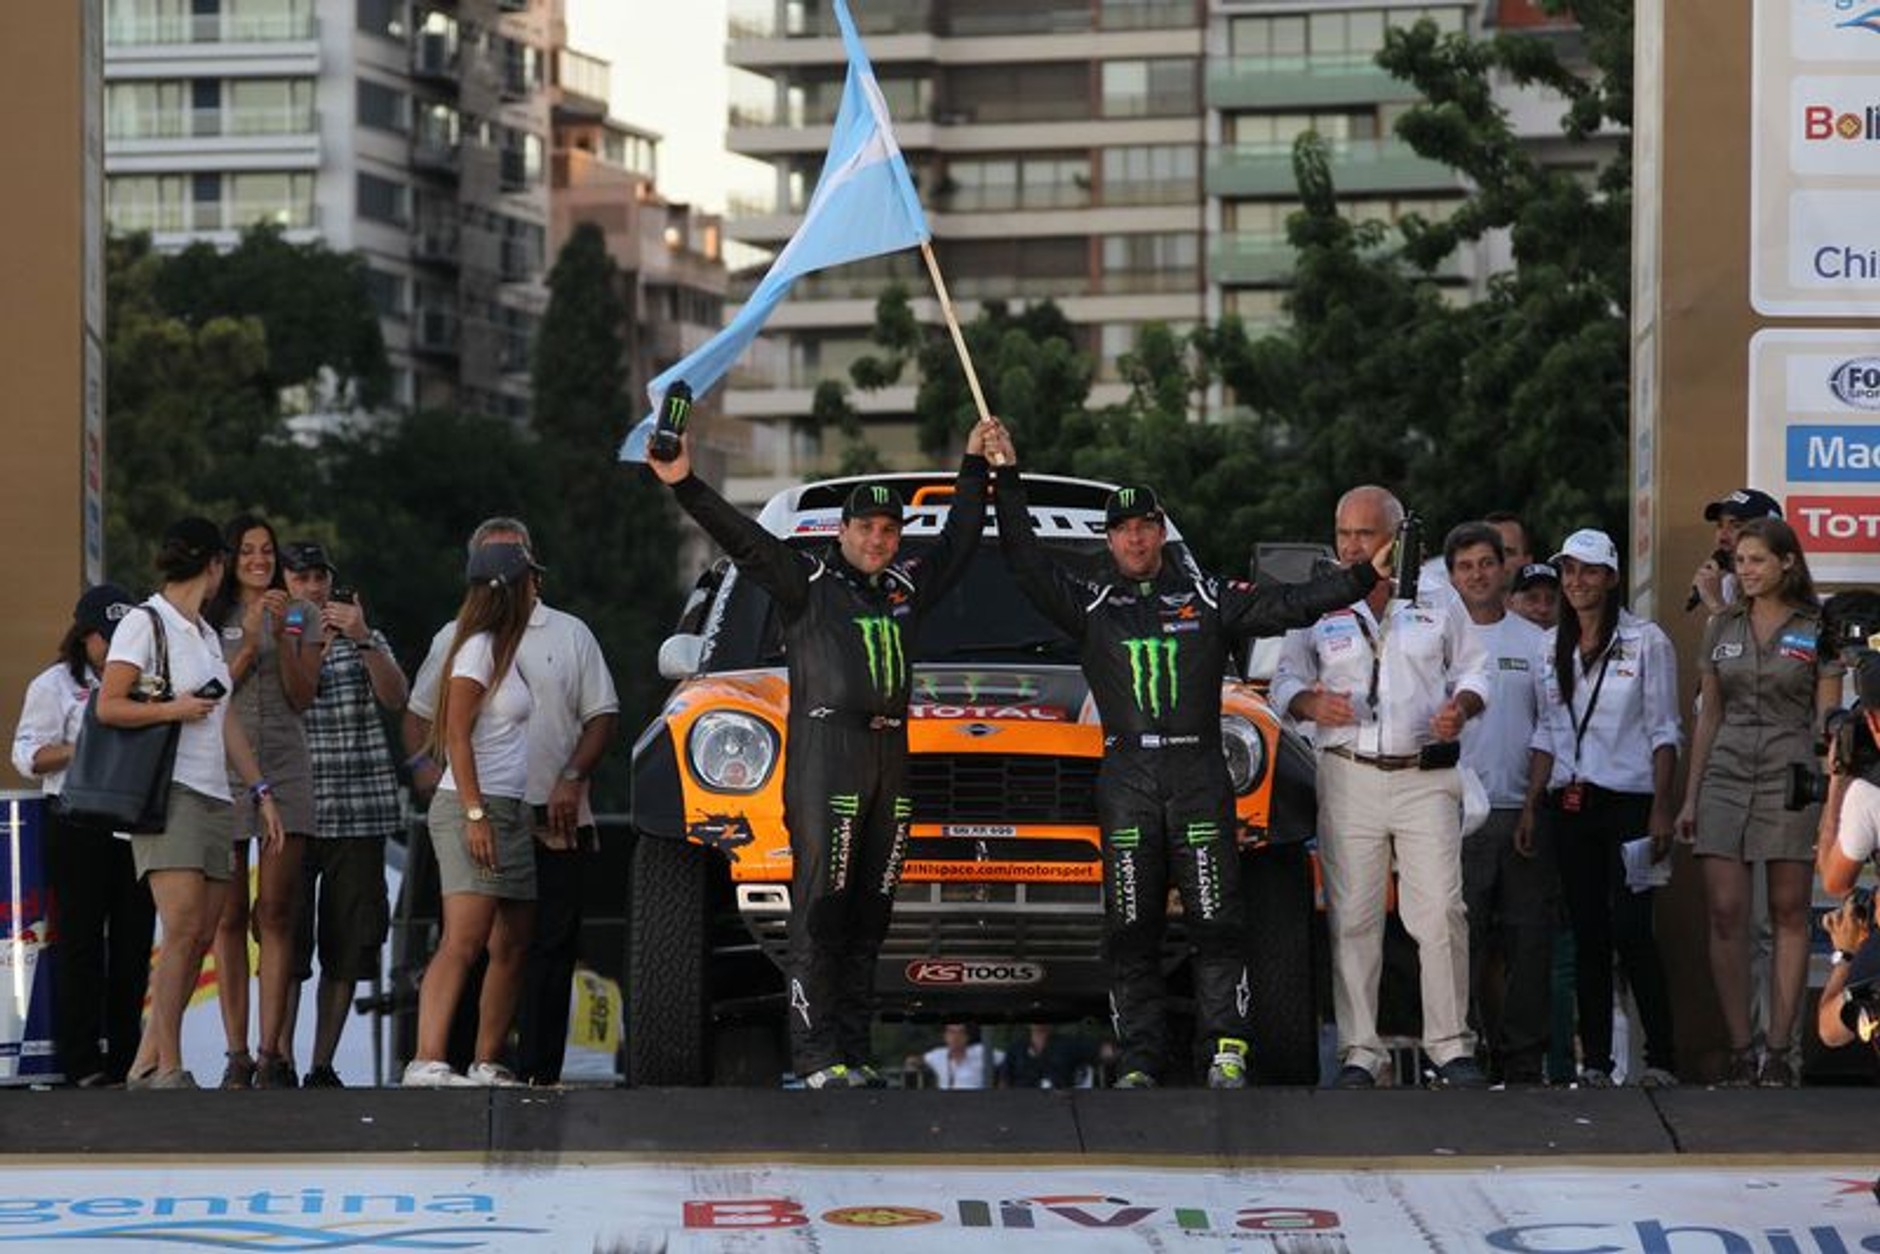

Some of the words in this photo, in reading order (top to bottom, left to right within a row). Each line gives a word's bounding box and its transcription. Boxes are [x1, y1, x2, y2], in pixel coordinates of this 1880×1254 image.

[908, 703, 1058, 720] TOTAL
[917, 965, 962, 980] KS
[967, 966, 1033, 980] TOOLS
